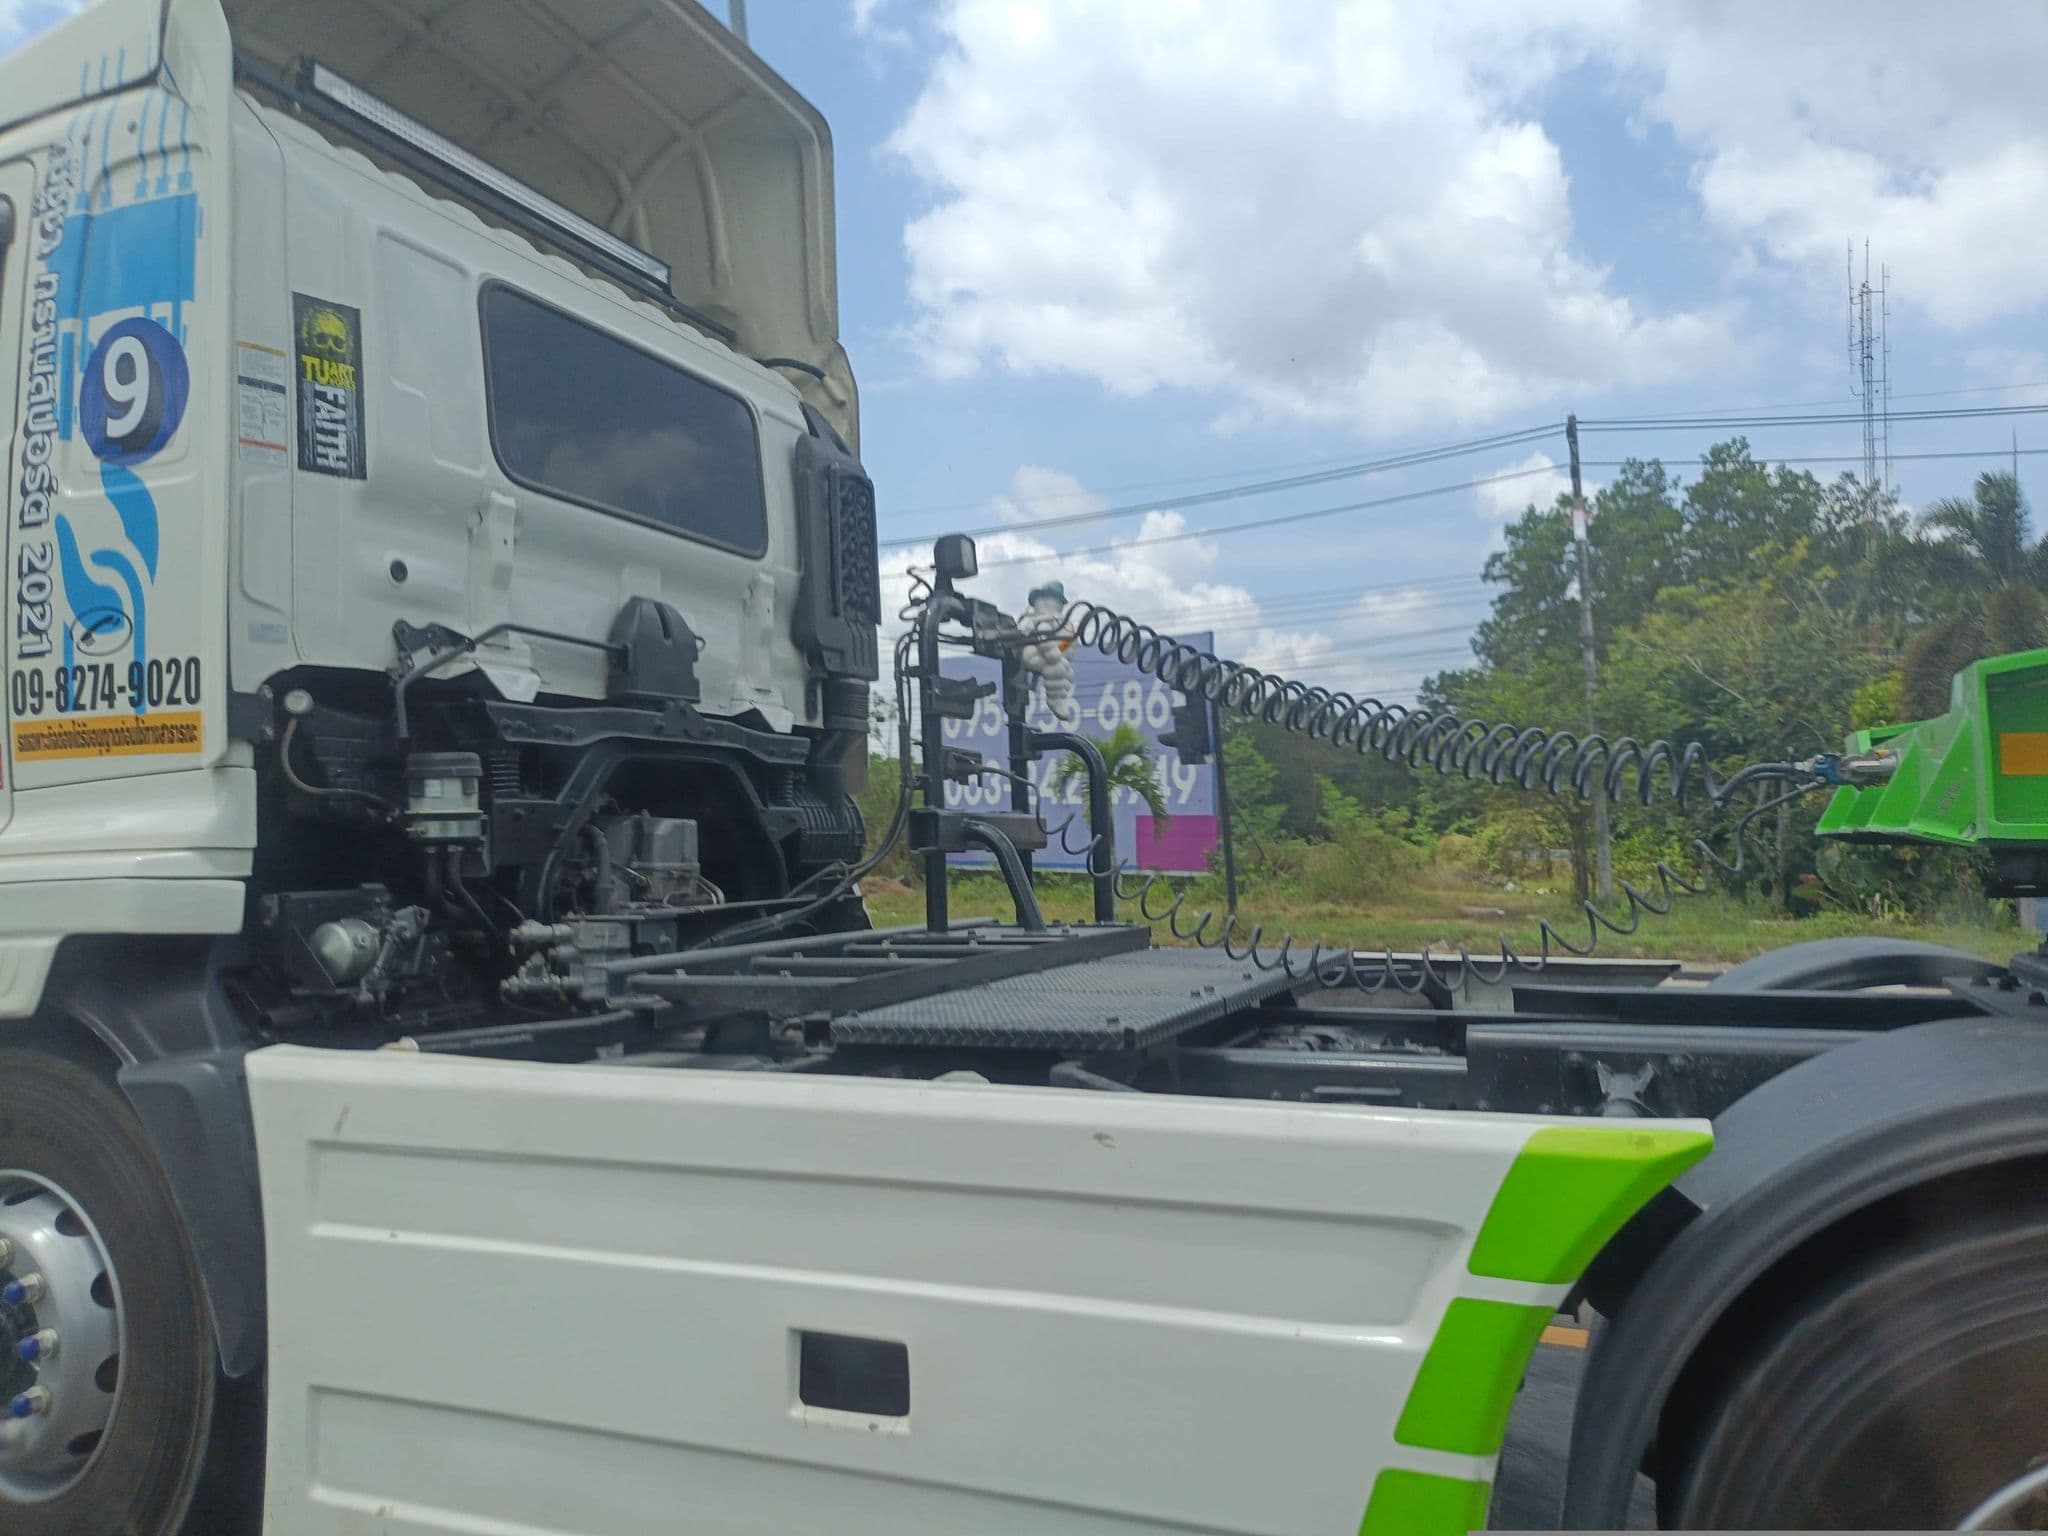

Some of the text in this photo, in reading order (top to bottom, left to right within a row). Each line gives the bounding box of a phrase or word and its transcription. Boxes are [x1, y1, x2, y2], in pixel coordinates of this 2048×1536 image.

[103, 335, 150, 438] 9
[314, 383, 348, 470] FAITH
[18, 541, 53, 660] 2021
[13, 656, 201, 716] 09-8274-9020
